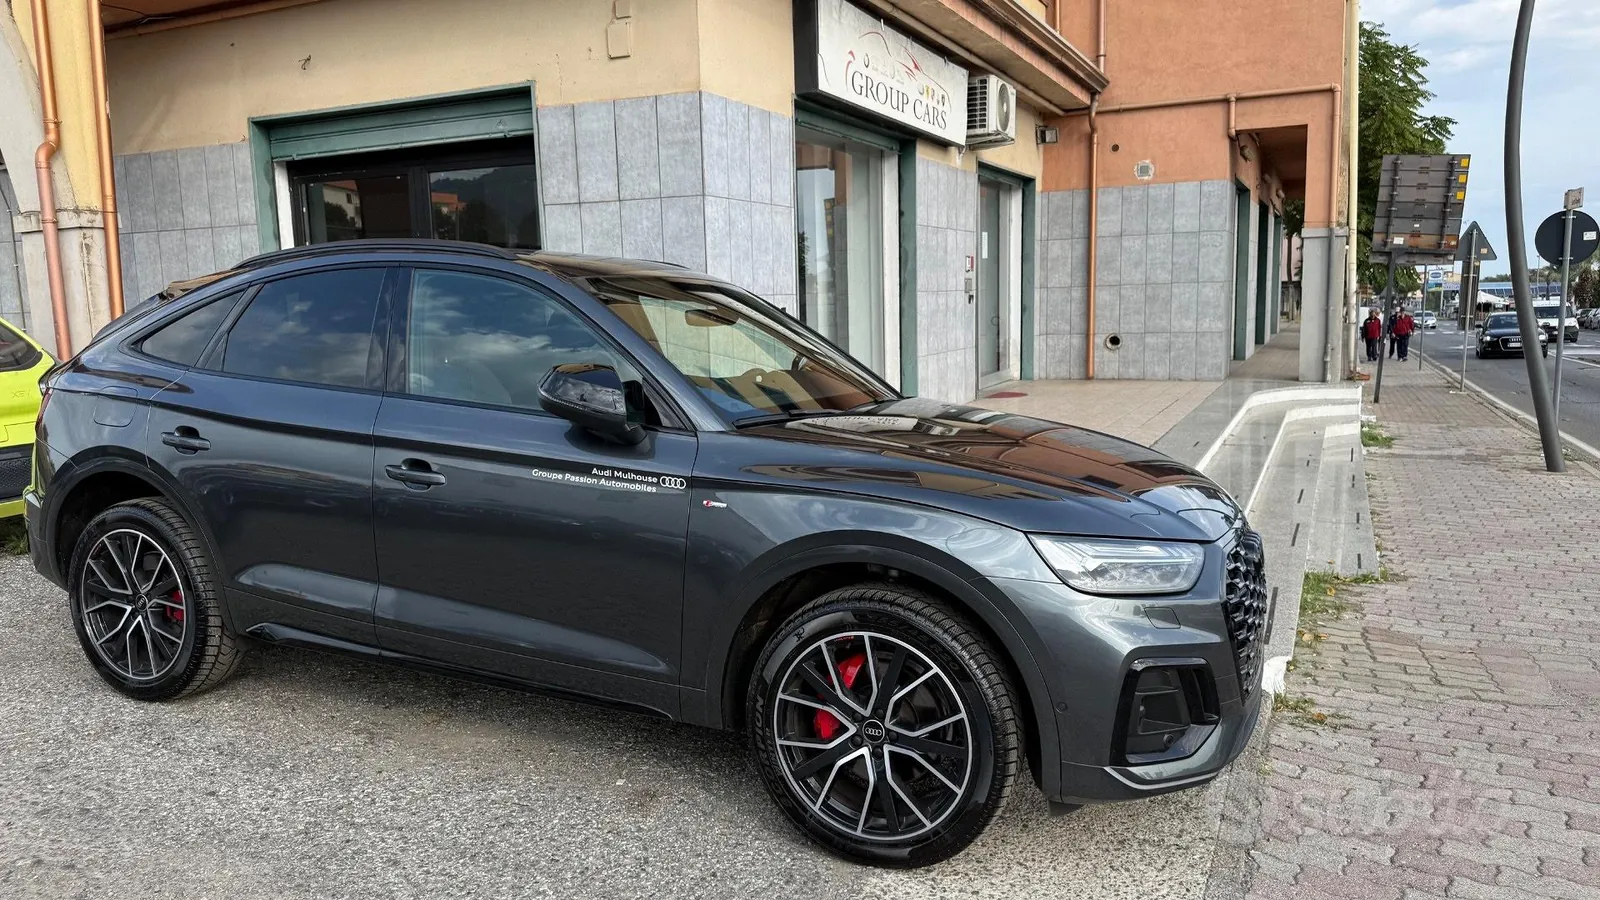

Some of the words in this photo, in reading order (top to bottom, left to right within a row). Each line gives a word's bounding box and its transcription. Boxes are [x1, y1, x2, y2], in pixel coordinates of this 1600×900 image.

[851, 71, 909, 114] GROUP
[913, 99, 948, 131] CARS
[531, 468, 563, 480] Groupe
[564, 473, 598, 485] Passion
[599, 480, 657, 493] Automobiles
[591, 467, 612, 478] Audi
[614, 470, 658, 484] Mulhouse
